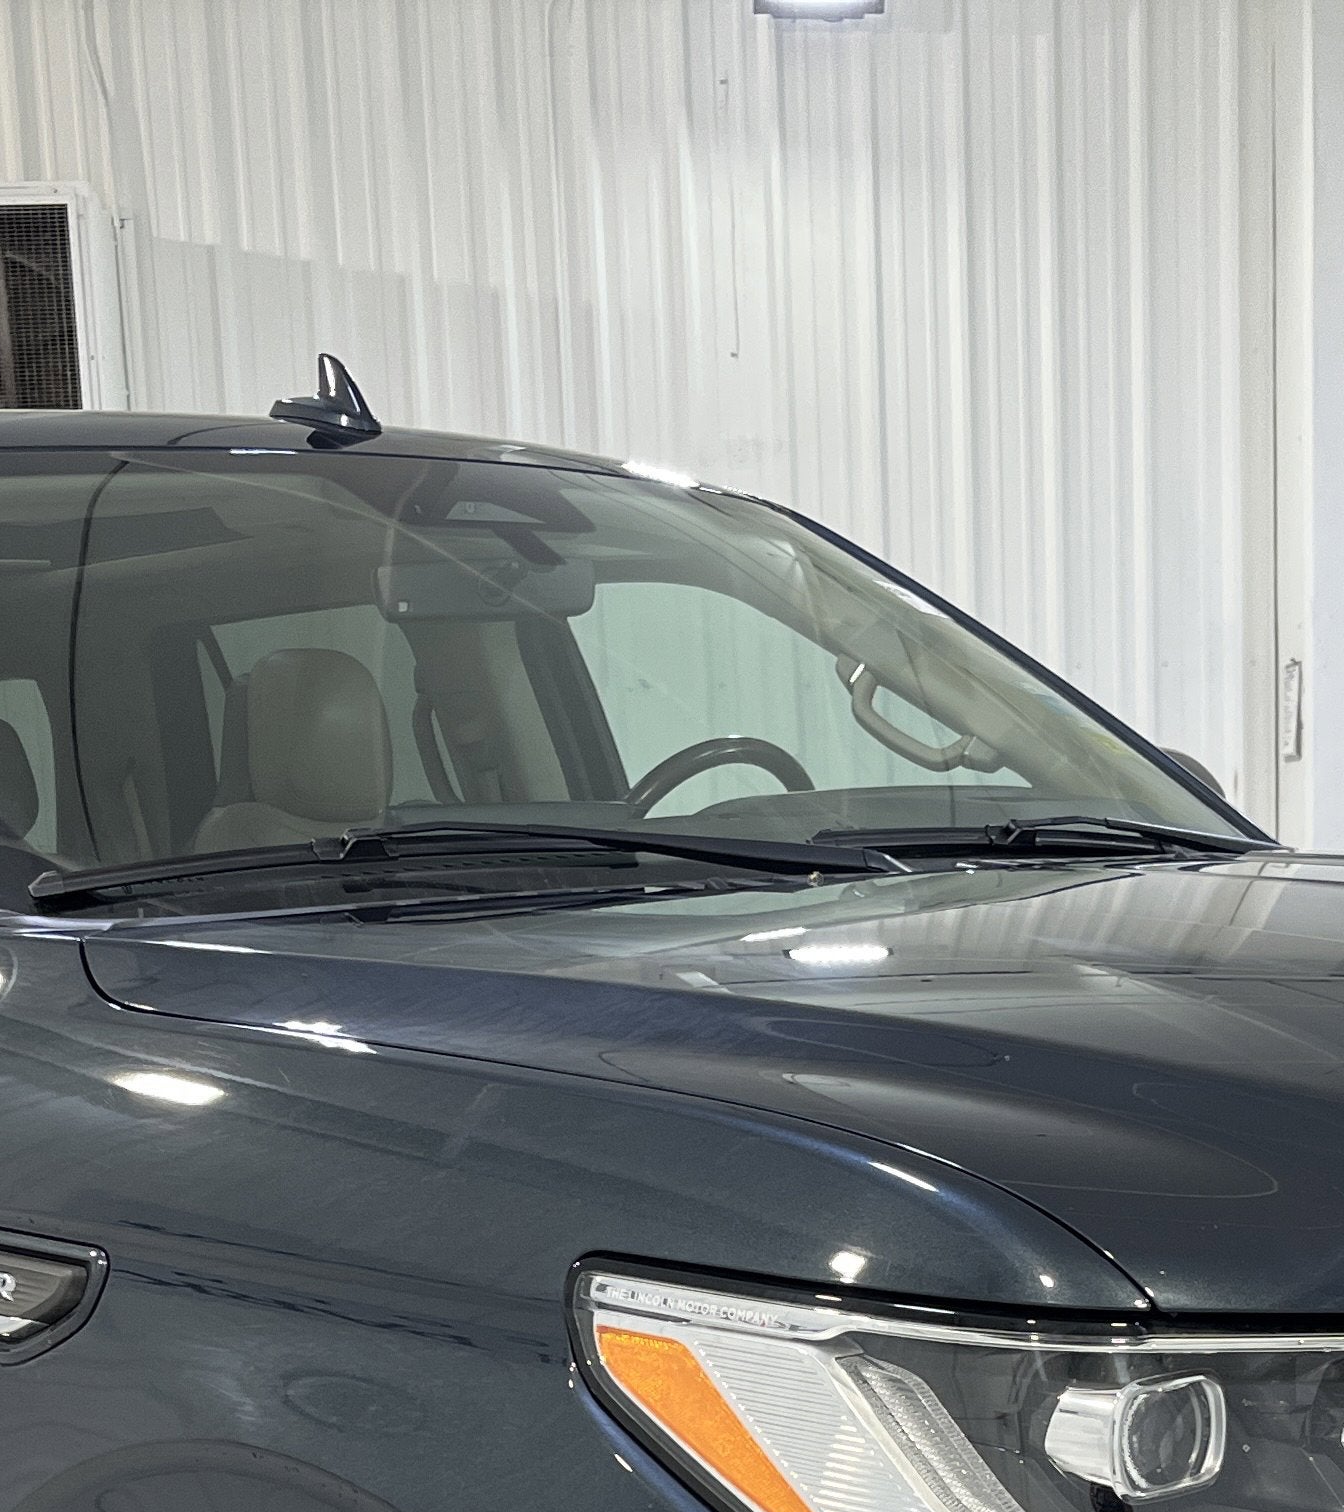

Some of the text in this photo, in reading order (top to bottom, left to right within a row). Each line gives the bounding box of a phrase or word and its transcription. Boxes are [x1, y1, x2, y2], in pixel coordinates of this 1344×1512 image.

[606, 1285, 778, 1327] THE LINCOLN MOTOR COMPANY
